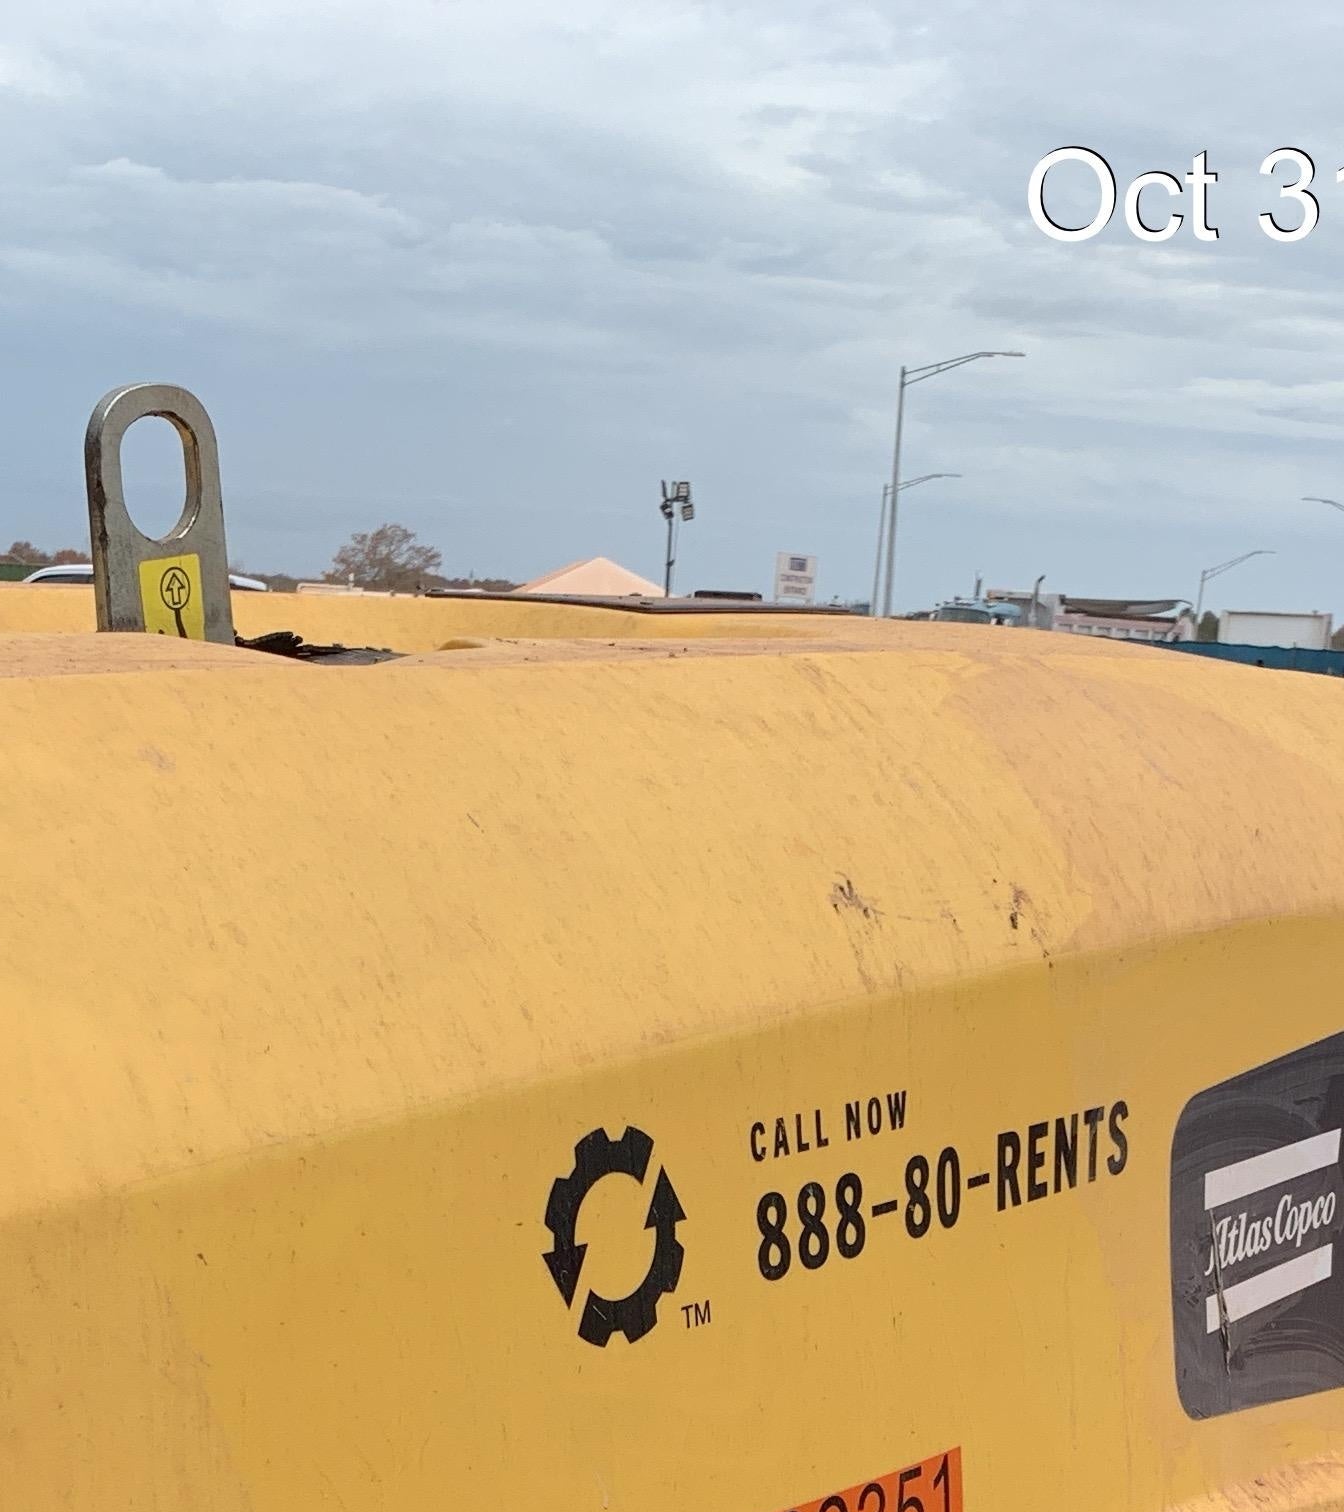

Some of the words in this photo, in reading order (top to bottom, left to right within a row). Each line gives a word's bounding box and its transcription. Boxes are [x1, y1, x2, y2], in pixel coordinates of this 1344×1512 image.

[751, 1110, 830, 1163] CALL
[845, 1090, 908, 1142] NOW
[756, 1100, 1130, 1282] 888-80-RENTS
[1204, 1212, 1272, 1277] Atlas
[1273, 1192, 1337, 1249] Copco
[680, 1298, 712, 1330] TM
